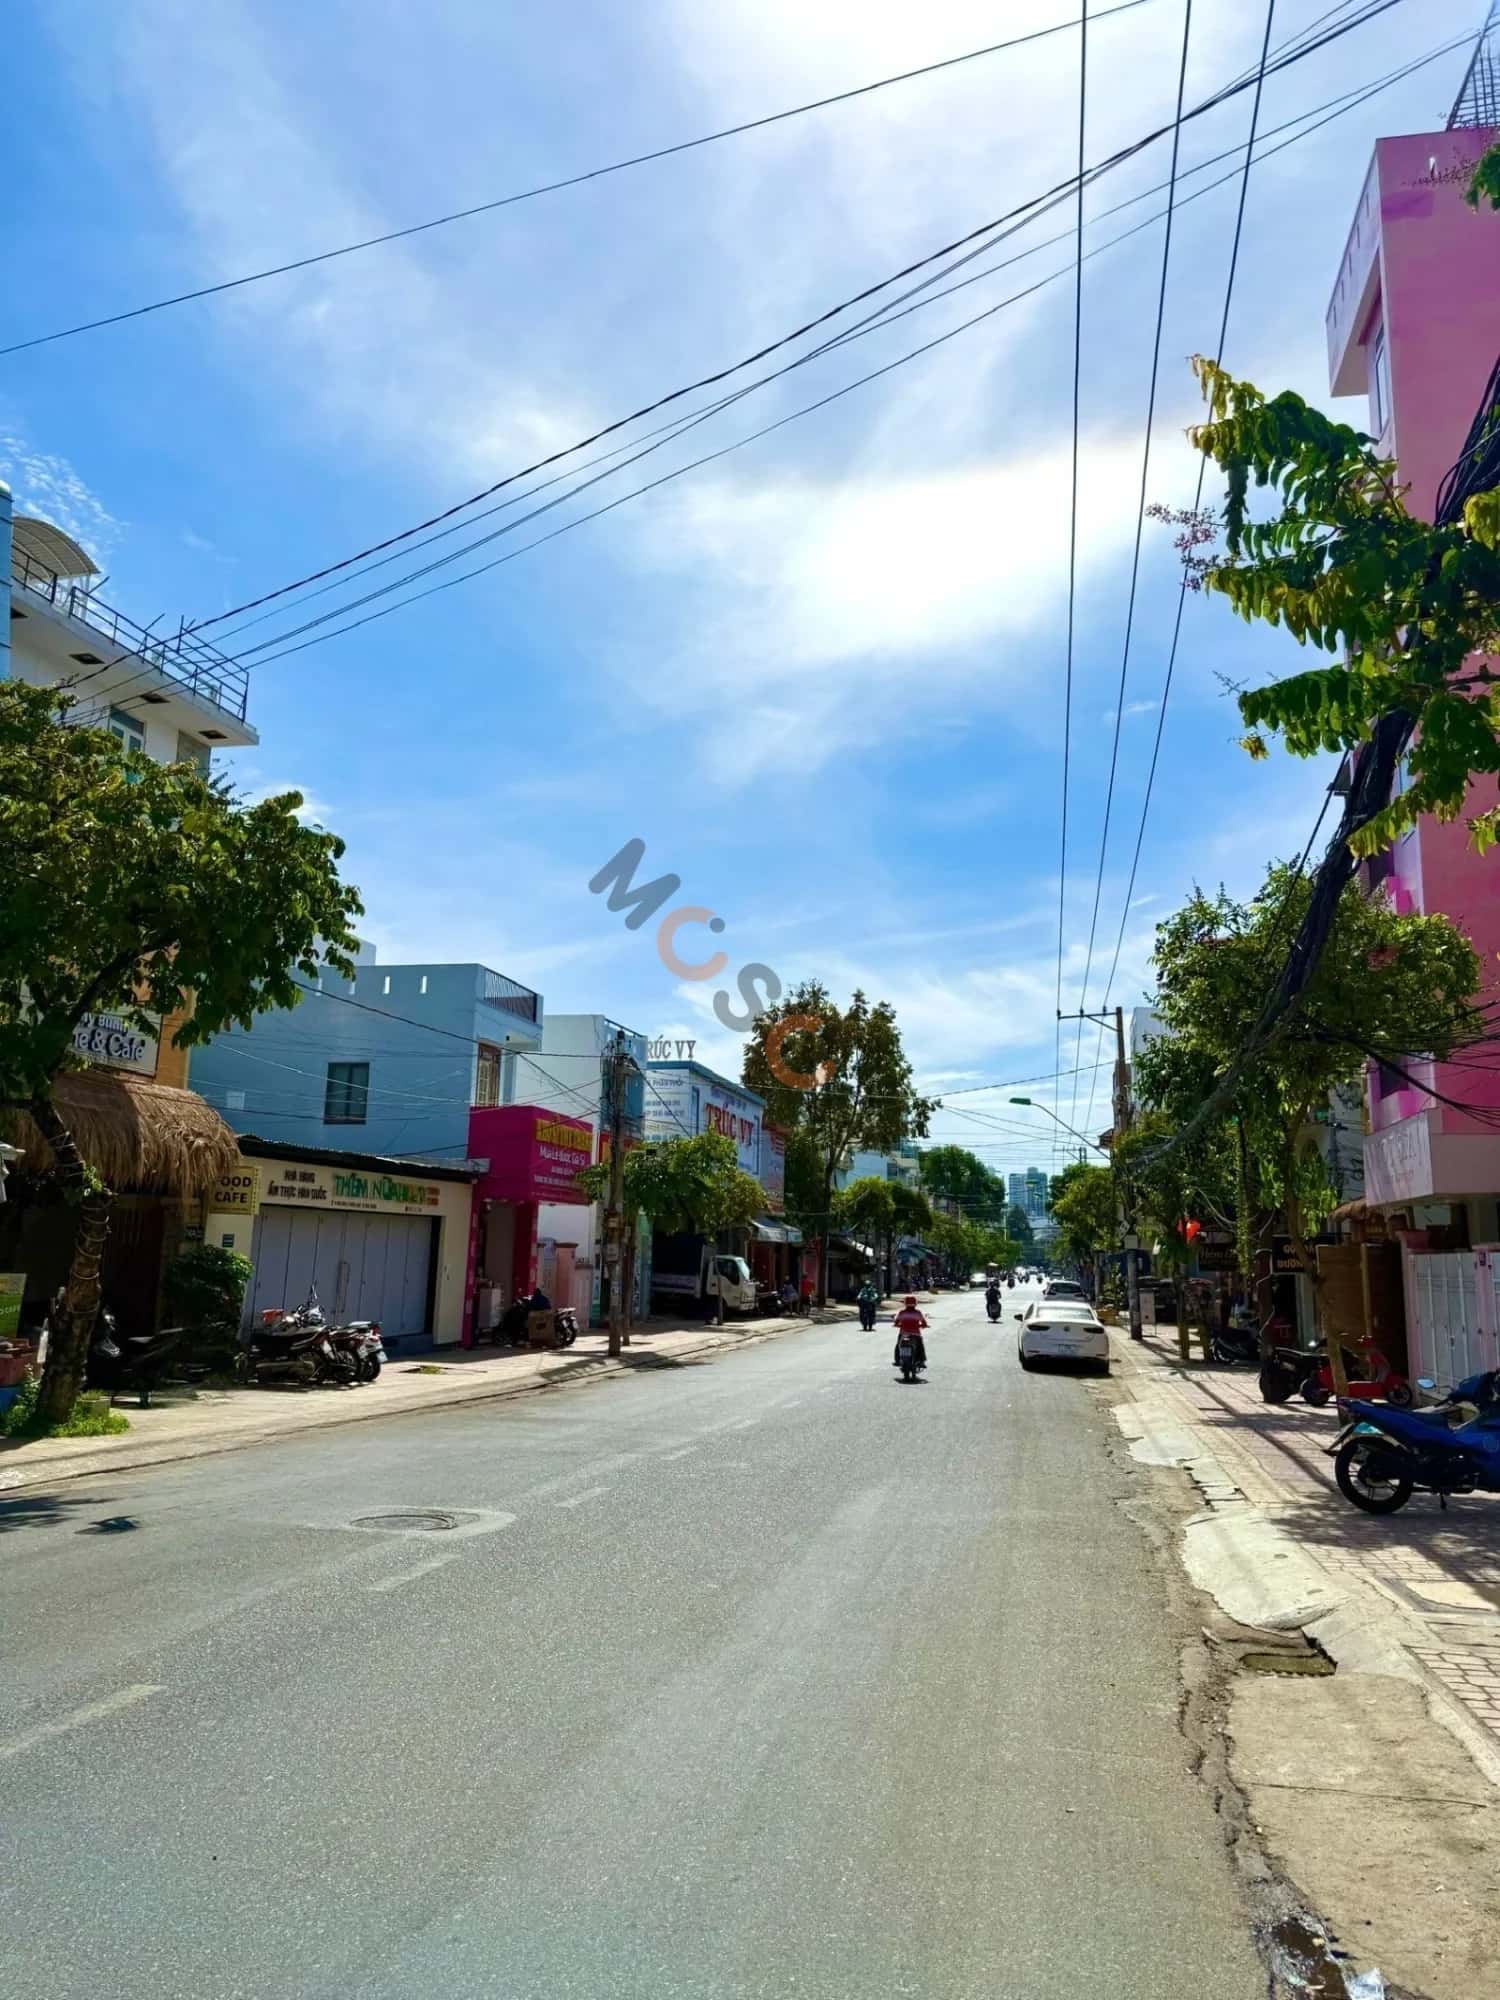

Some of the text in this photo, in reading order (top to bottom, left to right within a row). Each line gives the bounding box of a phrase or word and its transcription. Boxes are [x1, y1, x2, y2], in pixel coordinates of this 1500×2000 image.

[647, 1035, 697, 1059] RÚC VY
[214, 1191, 249, 1204] CAFE
